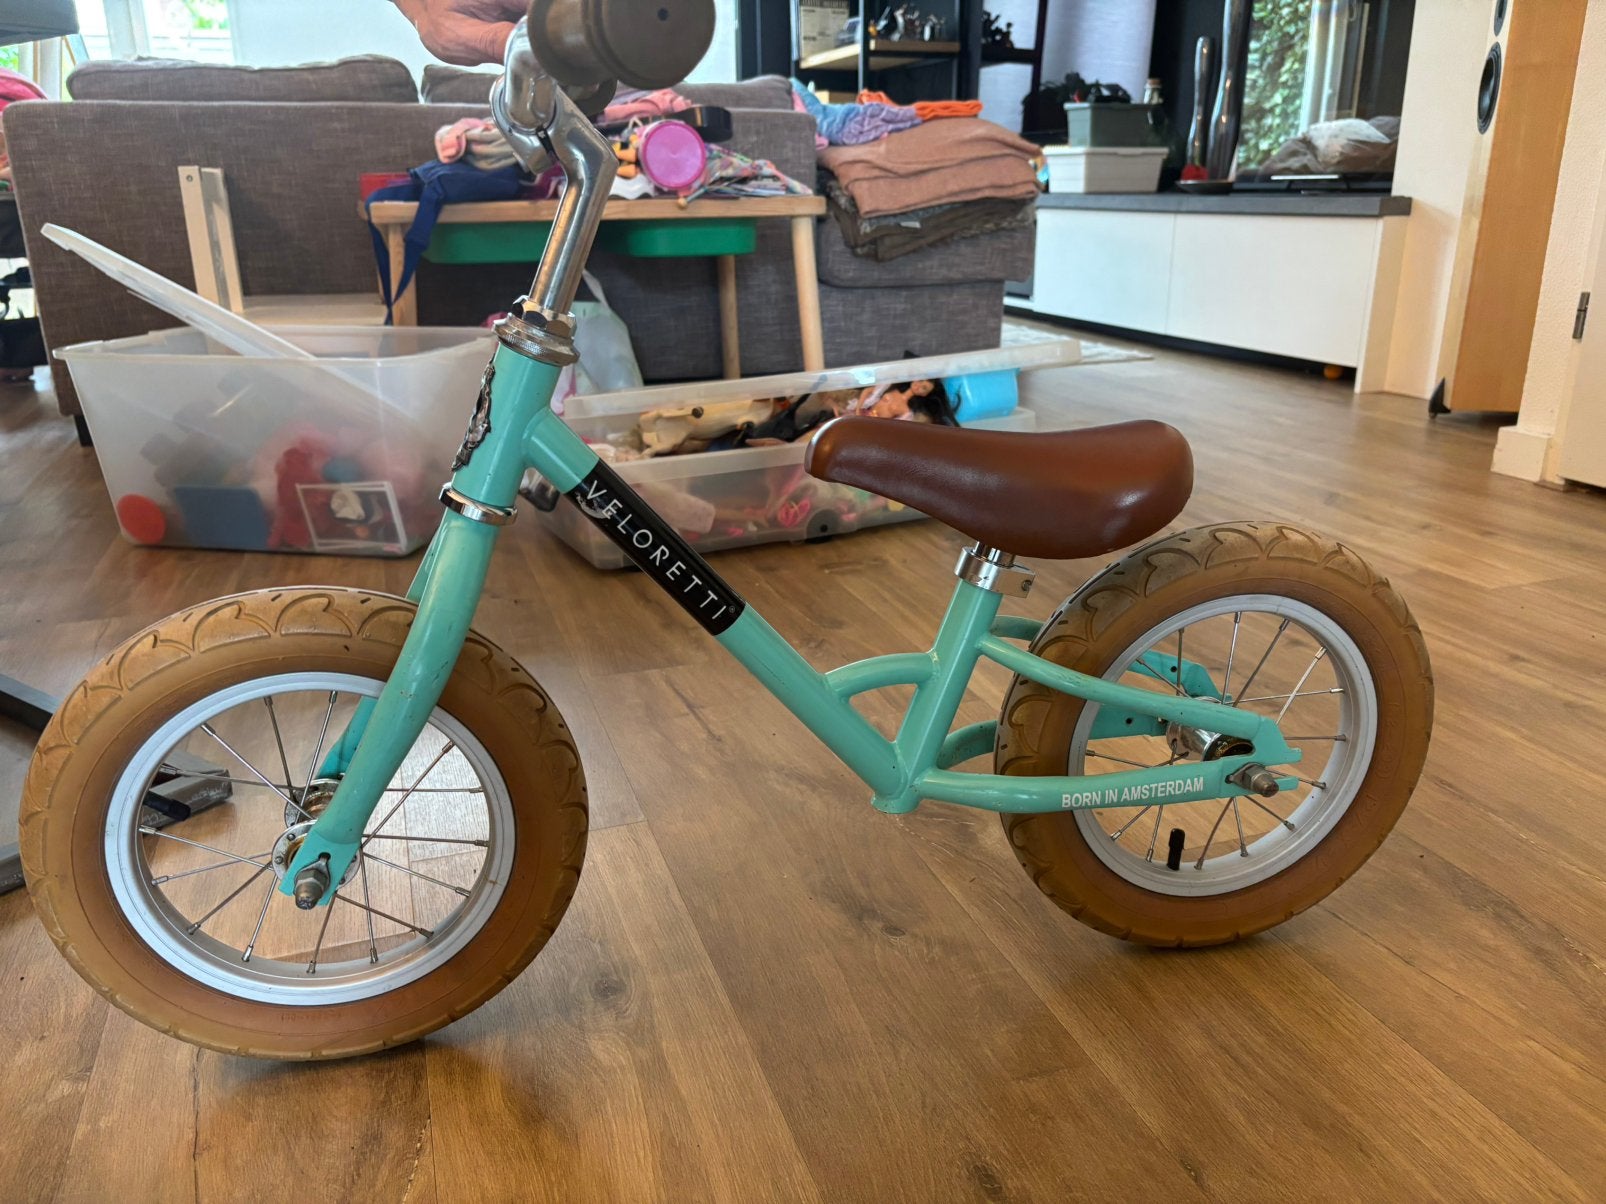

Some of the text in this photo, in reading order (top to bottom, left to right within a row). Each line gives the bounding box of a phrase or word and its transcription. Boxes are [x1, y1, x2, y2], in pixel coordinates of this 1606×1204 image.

[1061, 776, 1204, 808] BORN IN AMSTERDAM
